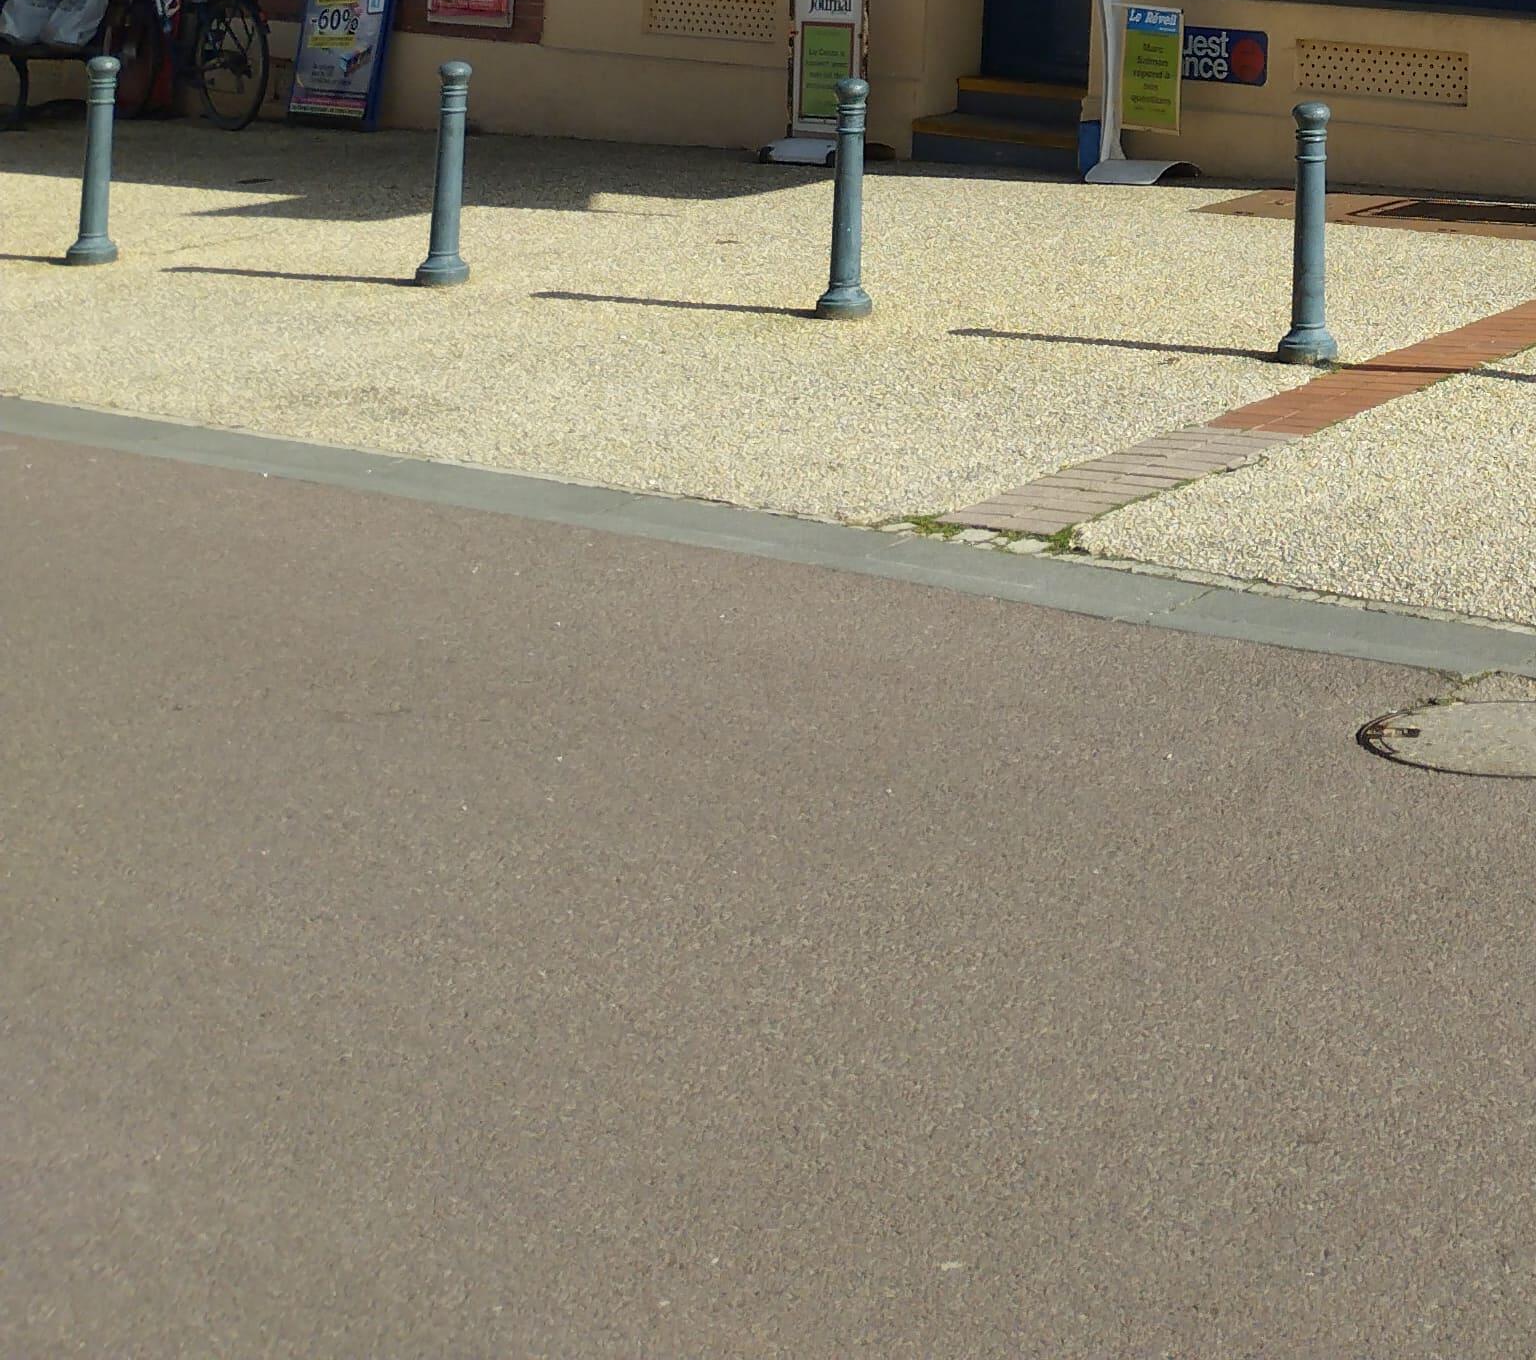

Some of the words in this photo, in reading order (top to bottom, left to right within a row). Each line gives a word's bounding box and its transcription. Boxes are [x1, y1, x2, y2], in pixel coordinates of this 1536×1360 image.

[312, 8, 358, 32] -60%
[1129, 9, 1142, 22] Le
[1144, 11, 1177, 26] Réveil
